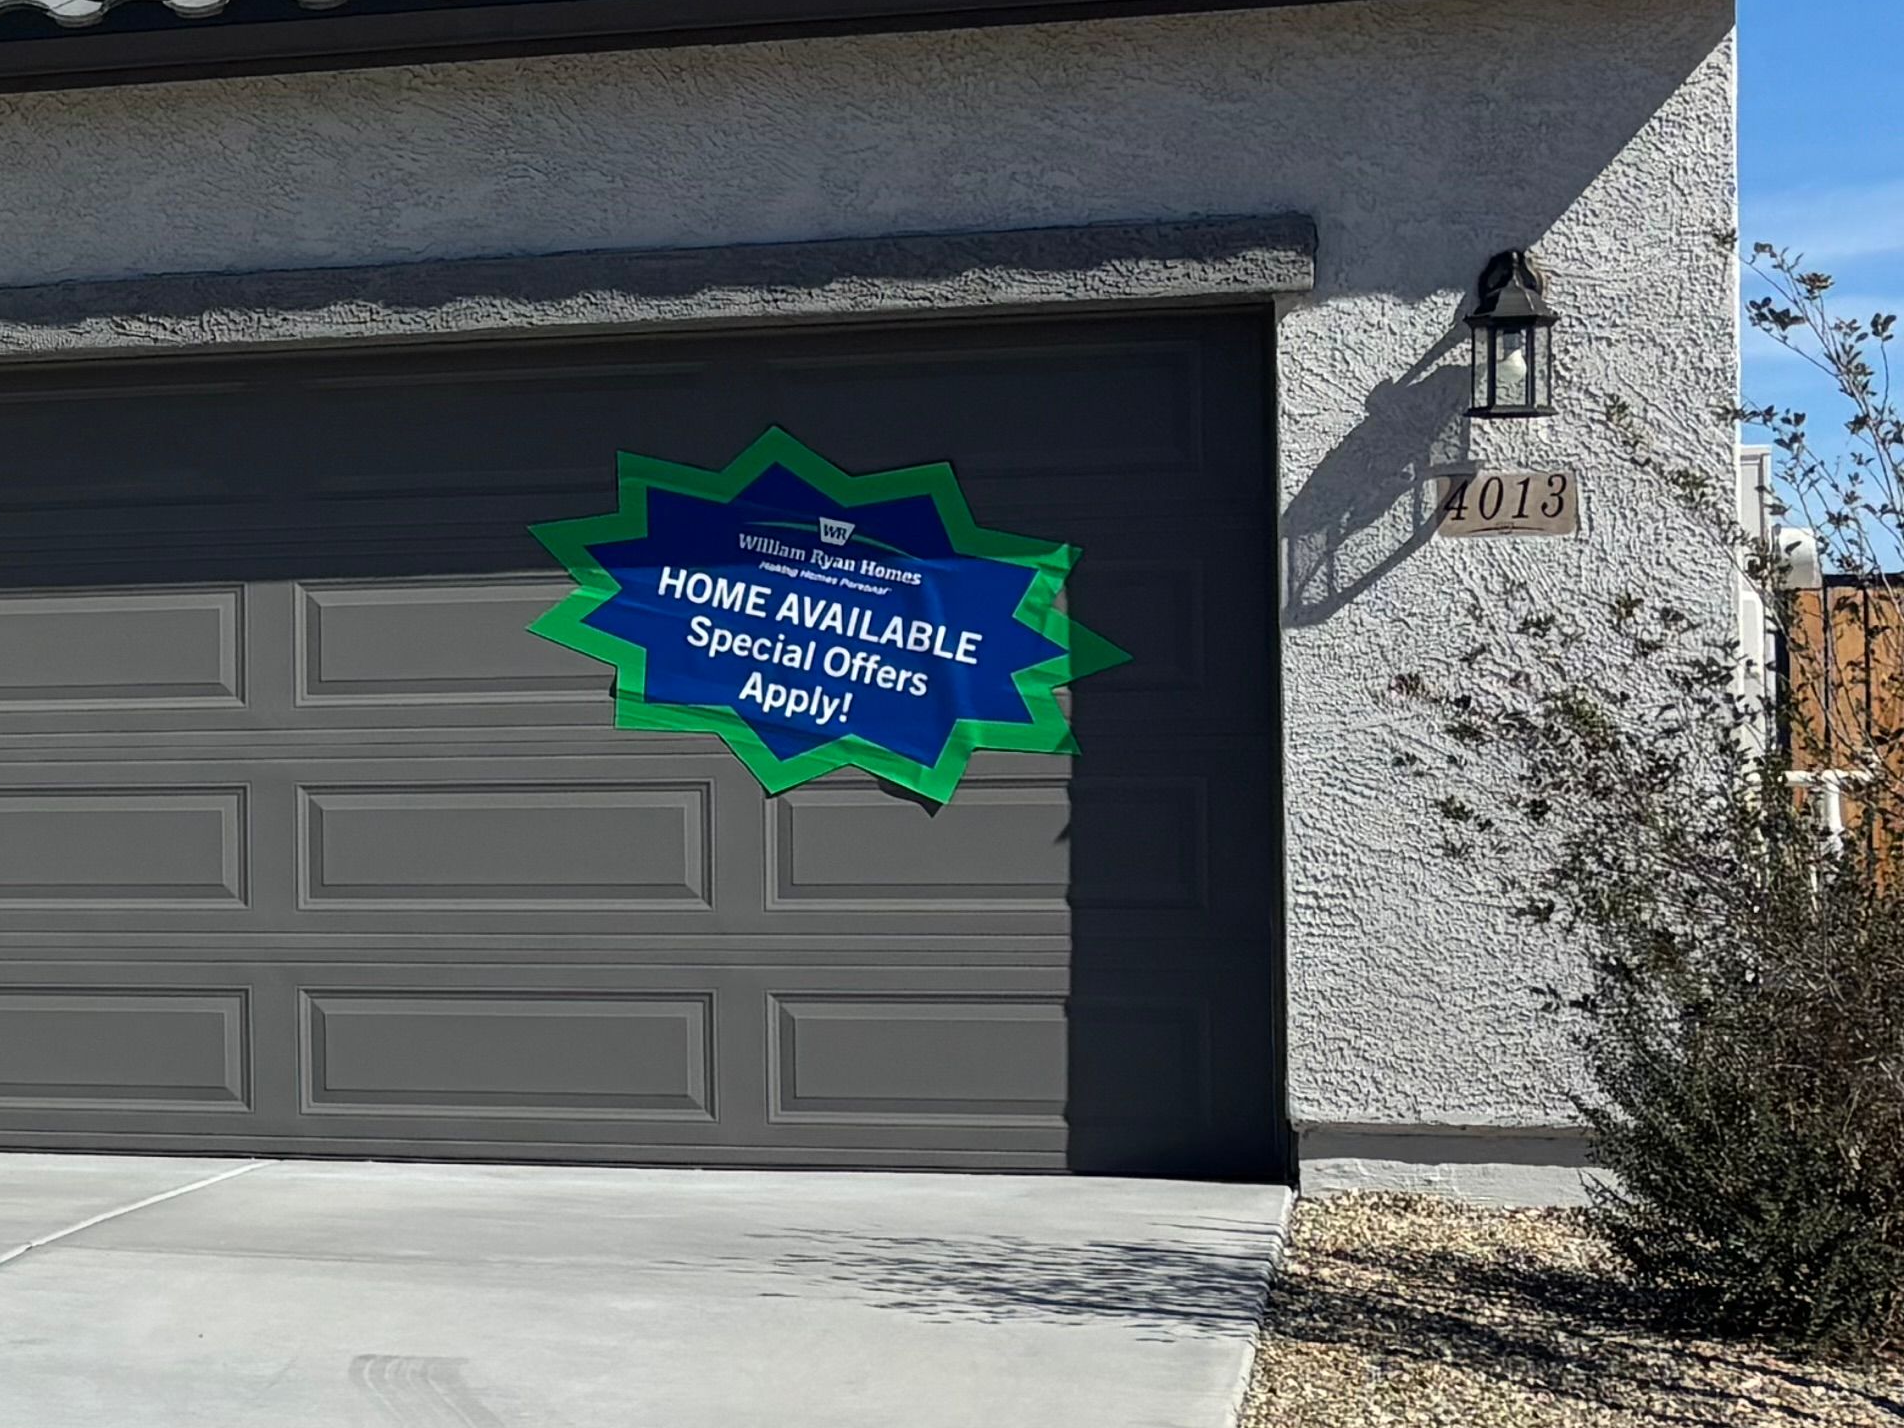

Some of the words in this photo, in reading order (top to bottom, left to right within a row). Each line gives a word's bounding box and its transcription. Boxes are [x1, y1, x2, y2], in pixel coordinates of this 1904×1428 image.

[1443, 473, 1568, 521] 4013
[822, 523, 848, 542] WR
[737, 533, 806, 562] William
[809, 548, 856, 573] Ryan
[859, 558, 923, 586] Homes
[758, 561, 799, 577] Making
[799, 570, 839, 586] Homes
[657, 566, 772, 618] HOME
[775, 592, 983, 665] AVAILABLE
[686, 615, 817, 670] Special
[823, 645, 930, 697] Offers
[738, 672, 853, 724] Apply!
